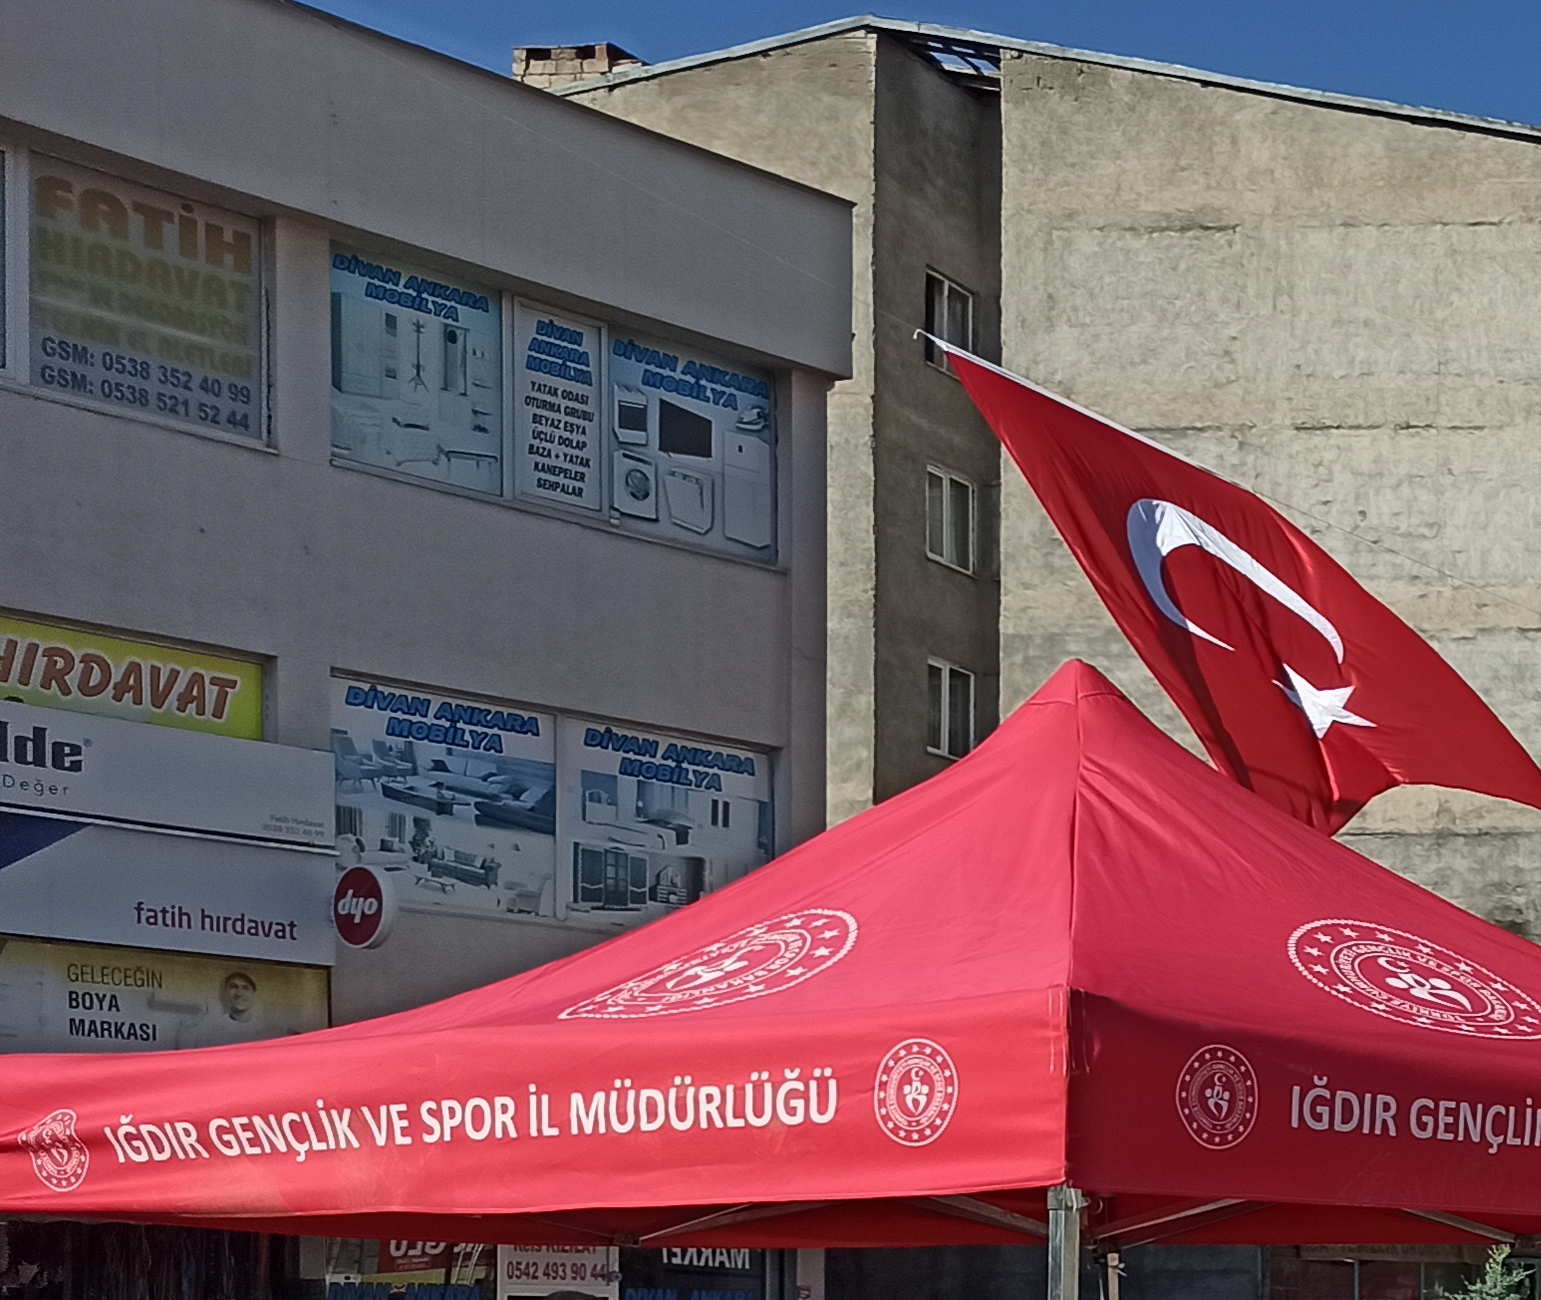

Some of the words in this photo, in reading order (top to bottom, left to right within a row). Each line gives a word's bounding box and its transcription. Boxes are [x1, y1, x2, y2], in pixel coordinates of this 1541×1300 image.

[35, 174, 250, 274] FATİH
[332, 252, 401, 288] DİVAN
[404, 275, 490, 314] ANKARA
[364, 281, 460, 323] MOBİLYA
[536, 319, 583, 347] DİVAN
[528, 337, 590, 368] ANKARA
[612, 339, 679, 373] DİVAN
[681, 360, 770, 399] ANKARA
[41, 336, 95, 367] GSM:
[102, 351, 150, 381] 0538
[157, 364, 193, 393] 352
[199, 374, 222, 400] 40
[228, 381, 251, 406] 99
[525, 354, 593, 387] MOBİLYA
[40, 364, 94, 395] GSM:
[101, 379, 149, 408] 0538
[156, 392, 190, 418] 521
[197, 403, 221, 427] 52
[226, 409, 250, 432] 44
[530, 380, 559, 399] YATAK
[561, 388, 589, 406] ODASI
[641, 368, 738, 411] MOBİLYA
[524, 396, 562, 417] OTURMA
[564, 406, 594, 423] GRUBU
[531, 413, 562, 430] BEYAZ
[563, 420, 587, 438] EŞYA
[528, 444, 552, 460] BAZA
[563, 452, 591, 469] YATAK
[531, 427, 556, 445] ÜÇLÜ
[557, 435, 587, 452] DOLAP
[533, 460, 586, 484] KANEPELER
[536, 477, 584, 499] SEHPALAR
[345, 684, 430, 718] DİVAN
[434, 701, 540, 737] ANKARA
[386, 717, 504, 754] MOBİLYA
[583, 727, 660, 760] DİVAN
[663, 743, 755, 776] ANKARA
[3, 774, 69, 797] Değer
[619, 757, 723, 792] MOBİLYA
[134, 901, 192, 930] fatih
[200, 907, 298, 941] hırdavat
[338, 889, 378, 924] dyo
[68, 990, 121, 1013] BOYA
[68, 1018, 158, 1042] MARKASI
[103, 1114, 210, 1164] IĞDIR
[208, 1099, 361, 1163] GENÇLİK
[361, 1104, 412, 1147] VE
[421, 1096, 517, 1144] SPOR
[529, 1084, 560, 1137] İL
[570, 1067, 838, 1136] MÜDÜRLÜĞÜ
[1291, 1075, 1397, 1137] IĞDIR
[507, 1261, 539, 1281] 0542
[543, 1262, 567, 1282] 493
[571, 1264, 587, 1282] 90
